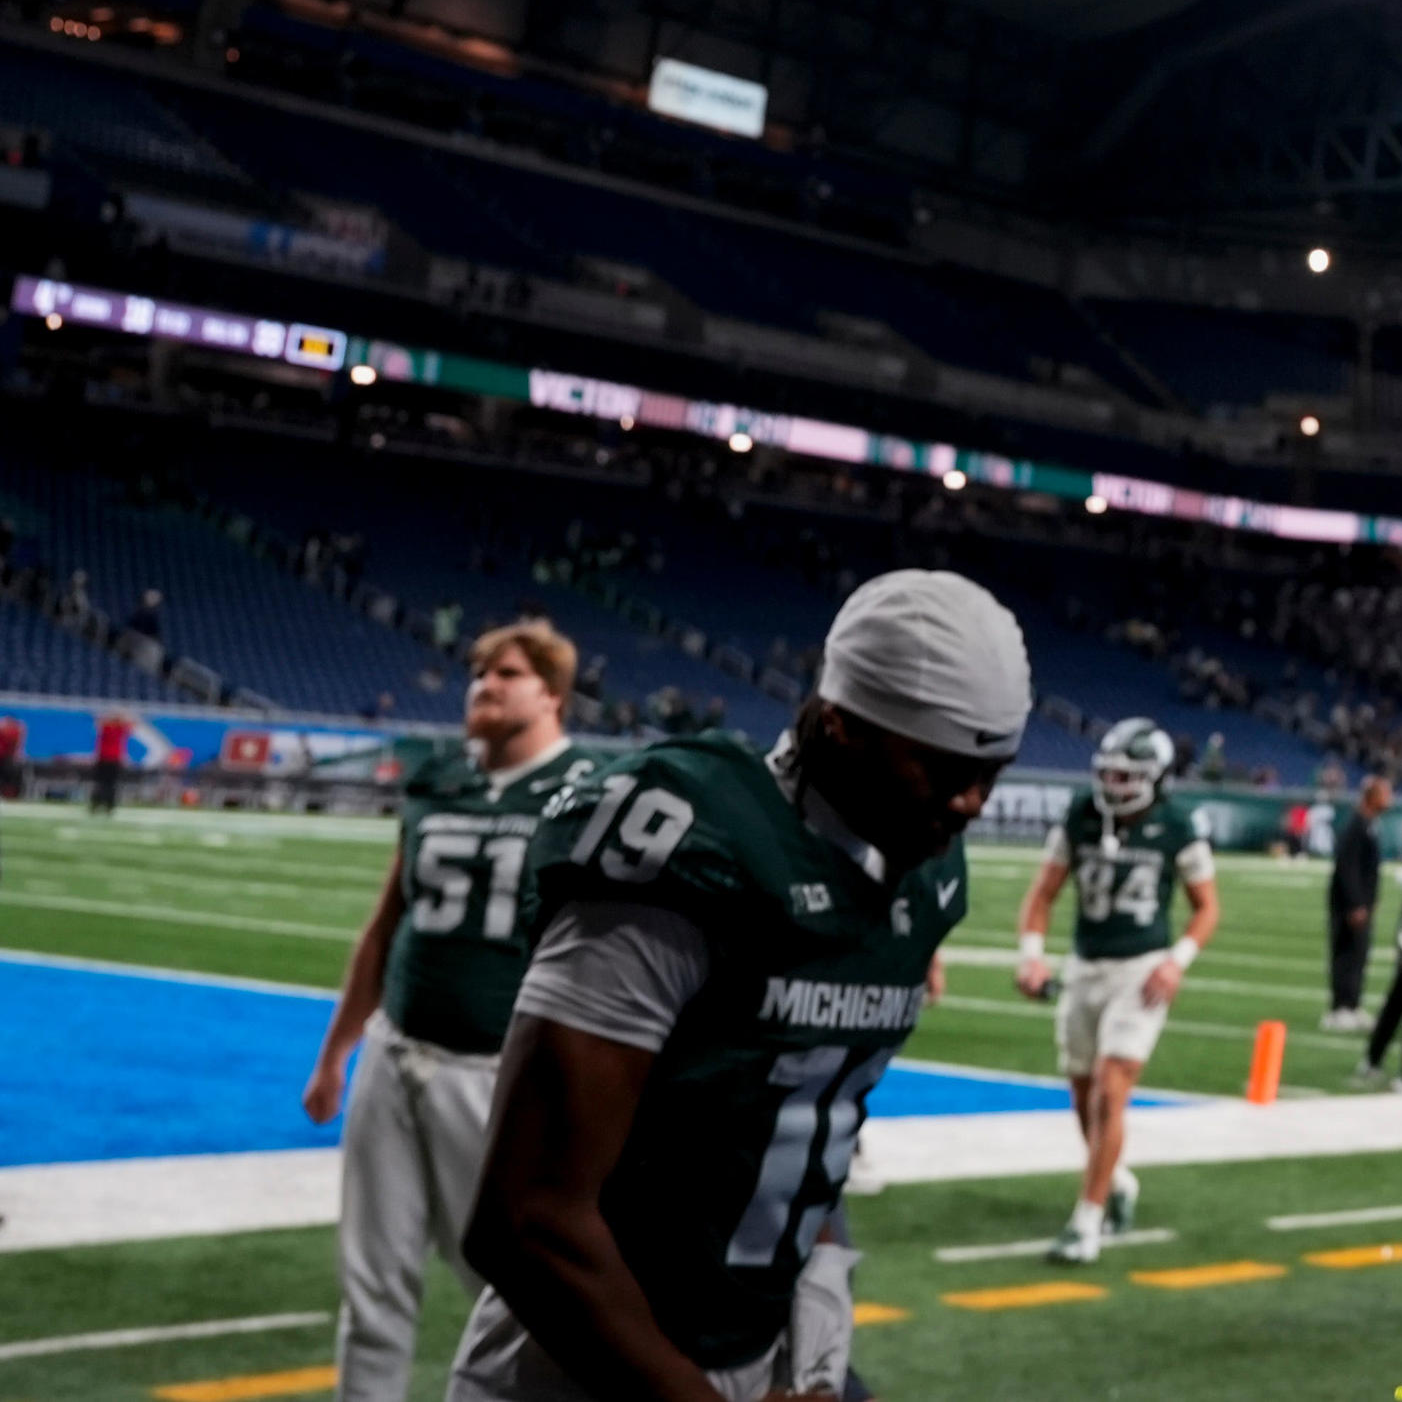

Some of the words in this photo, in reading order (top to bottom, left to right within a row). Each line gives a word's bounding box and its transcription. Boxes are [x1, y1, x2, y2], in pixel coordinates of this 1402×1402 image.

[570, 773, 694, 883] 19
[412, 833, 529, 940] 51
[757, 974, 908, 1030] MICHIGAN
